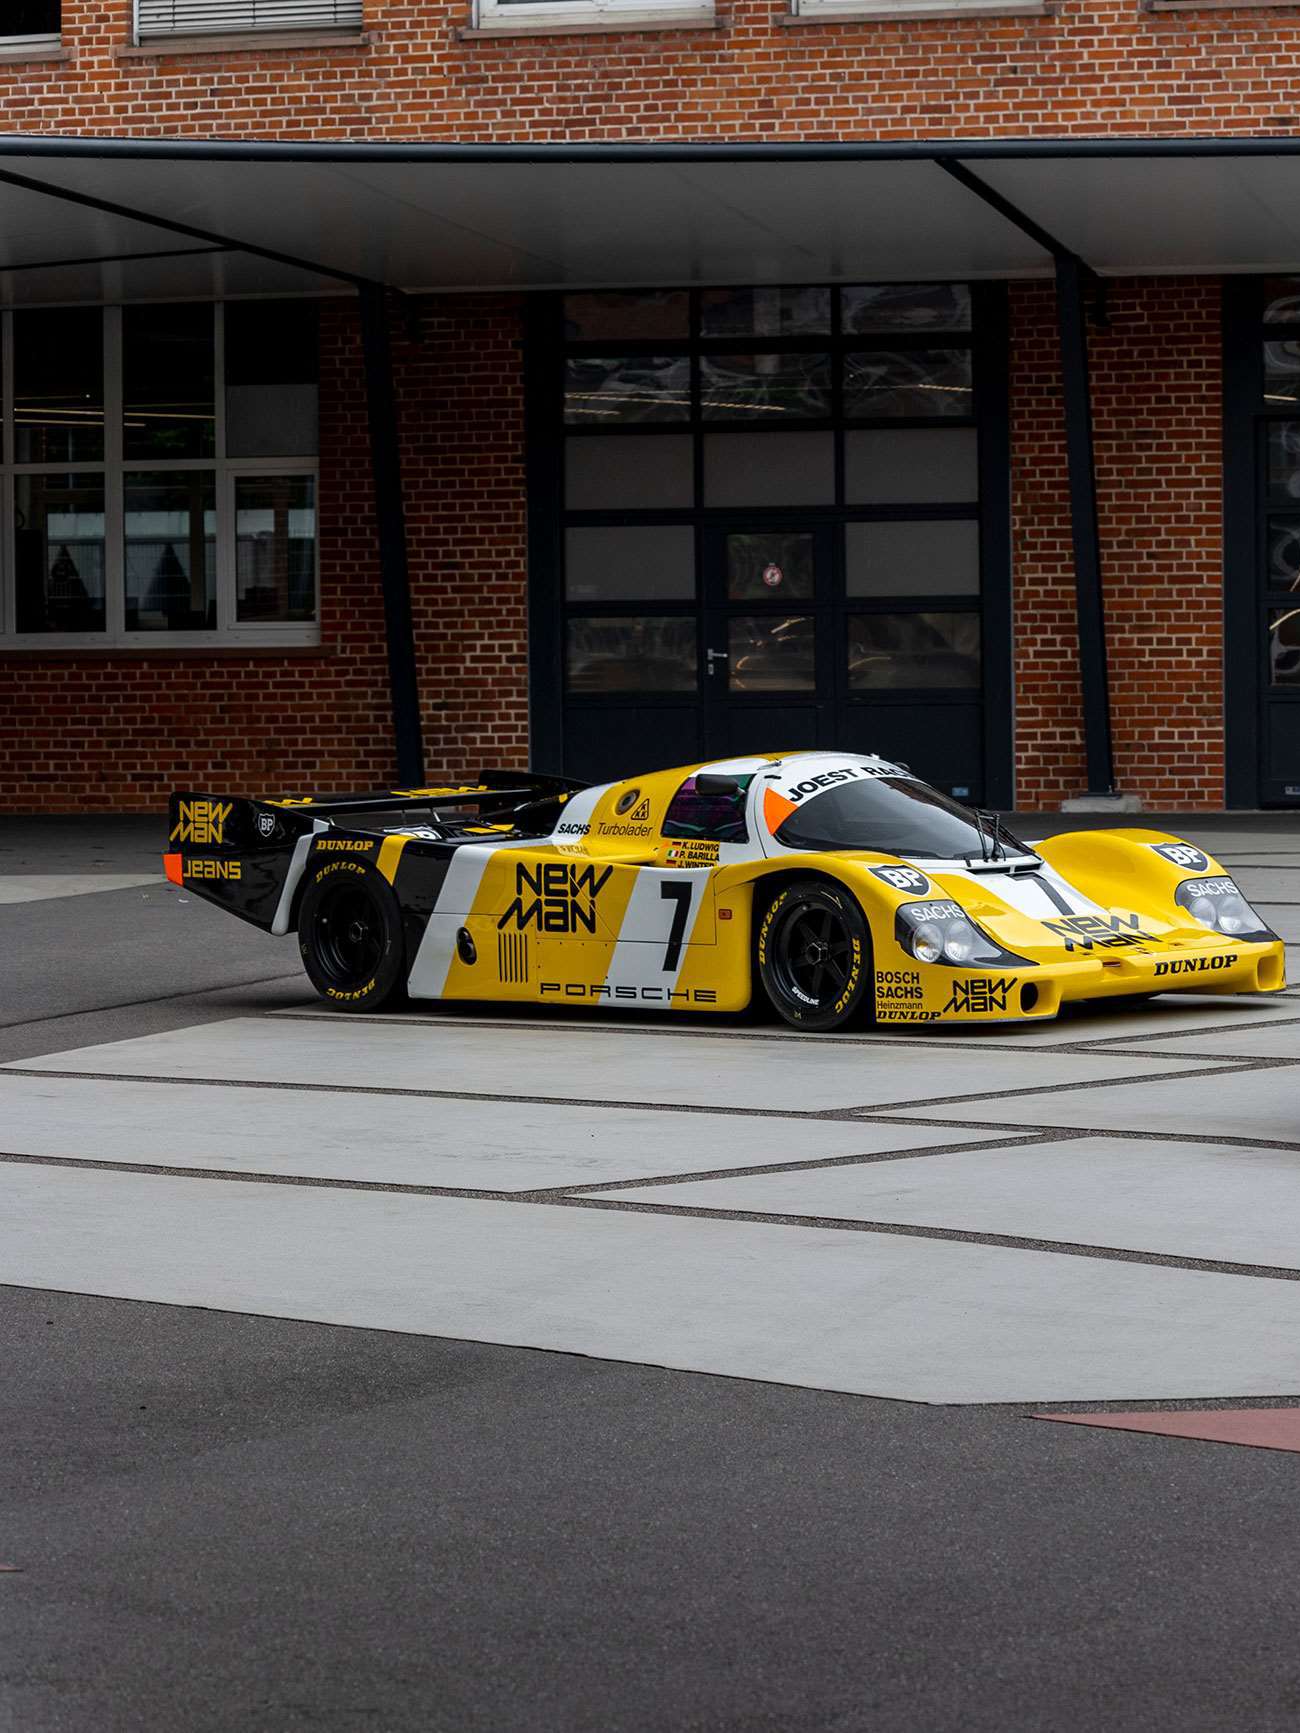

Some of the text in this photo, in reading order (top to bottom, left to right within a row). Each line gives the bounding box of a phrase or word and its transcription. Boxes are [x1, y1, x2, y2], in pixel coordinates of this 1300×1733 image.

[790, 766, 912, 801] JOEST RAC
[261, 818, 273, 831] BP
[558, 823, 591, 835] SACHS
[597, 823, 653, 836] Turbolader
[316, 840, 373, 851] DUNLOP
[1166, 847, 1200, 865] BP
[315, 861, 366, 883] DUNLOP
[880, 870, 924, 888] BP
[1008, 872, 1075, 915] 7
[1187, 881, 1238, 897] SACHS
[911, 906, 965, 921] SACHS
[660, 880, 693, 972] 7
[758, 891, 788, 965] DUNLOP
[1154, 954, 1238, 976] DUNLOP
[876, 972, 920, 984] BOSCH
[540, 983, 717, 1002] PORSCHE
[876, 986, 923, 999] SACHS
[877, 1001, 923, 1010] Heinzmann
[876, 1011, 941, 1021] DUNLOP
